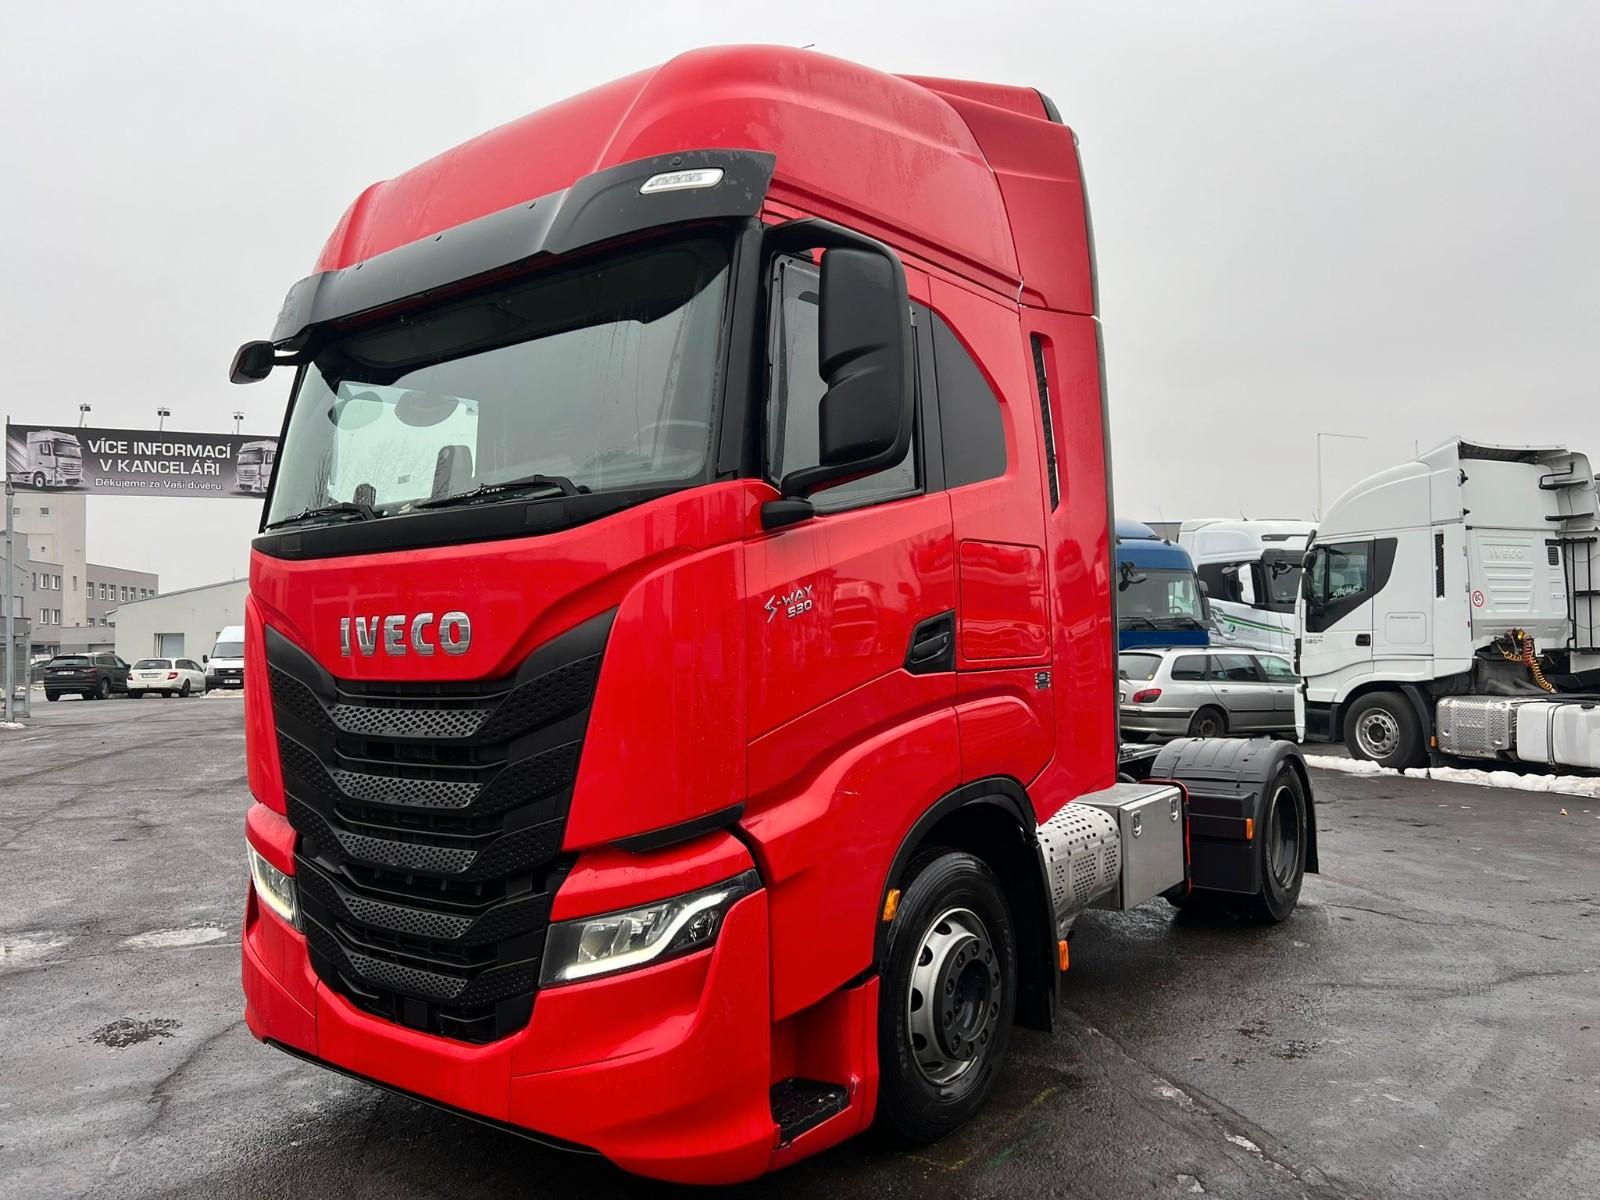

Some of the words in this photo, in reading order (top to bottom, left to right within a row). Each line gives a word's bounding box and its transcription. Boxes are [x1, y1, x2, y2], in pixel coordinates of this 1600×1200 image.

[88, 437, 128, 454] VÍCE
[133, 441, 232, 459] INFORMACÍ
[100, 458, 113, 472] V
[117, 459, 220, 476] KANCELÁŘI
[95, 477, 146, 488] Děkujeme
[787, 599, 813, 618] 530
[340, 611, 472, 656] IVECO
